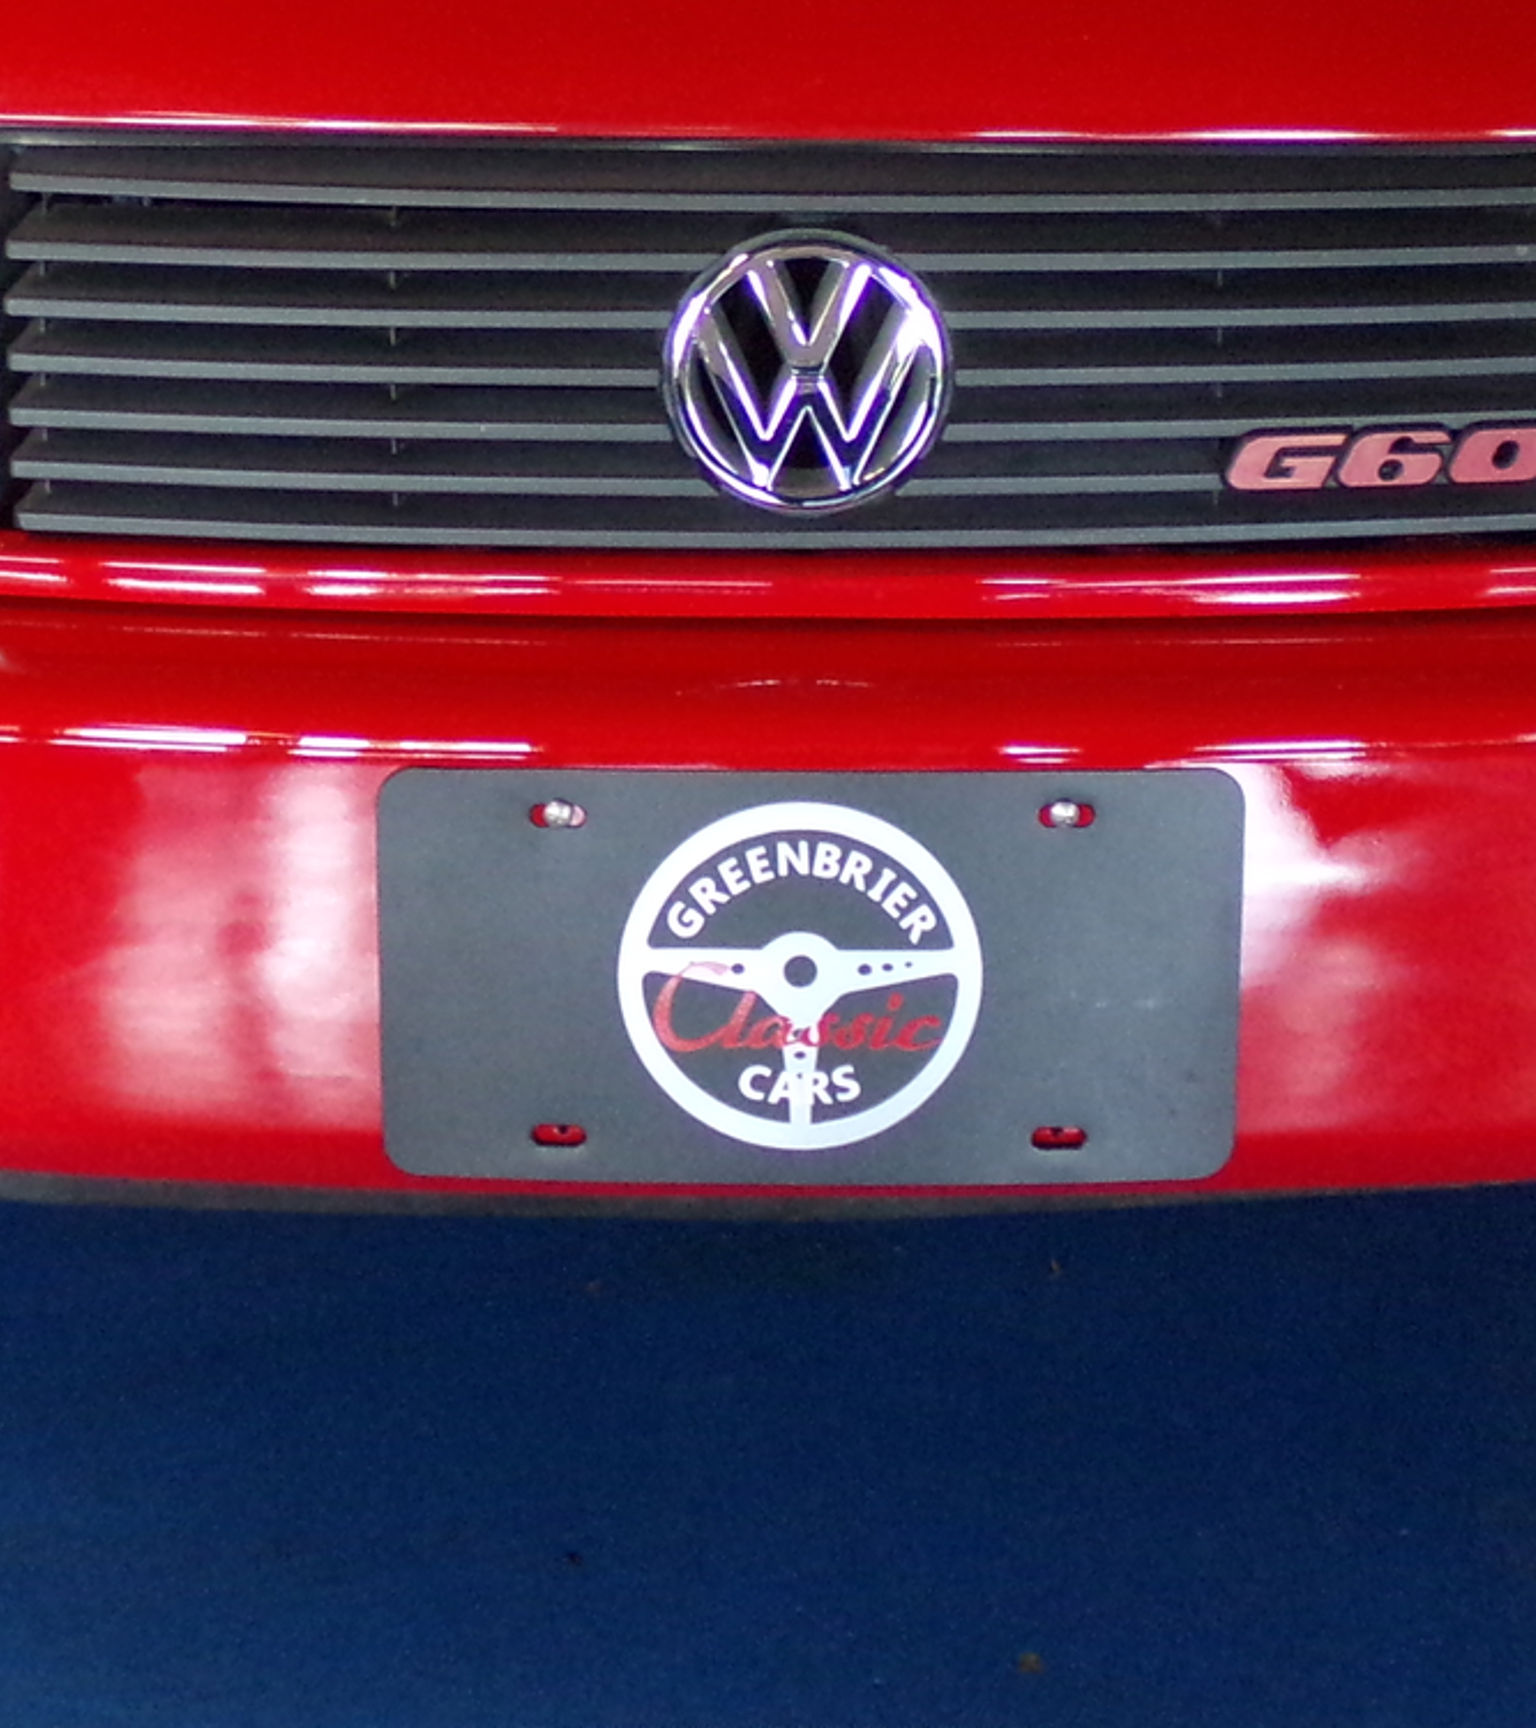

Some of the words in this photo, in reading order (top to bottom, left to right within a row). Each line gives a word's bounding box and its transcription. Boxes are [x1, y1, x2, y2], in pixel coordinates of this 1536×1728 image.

[665, 838, 939, 946] GREENBRIER
[651, 960, 942, 1055] Classic
[737, 1063, 864, 1108] CARS
